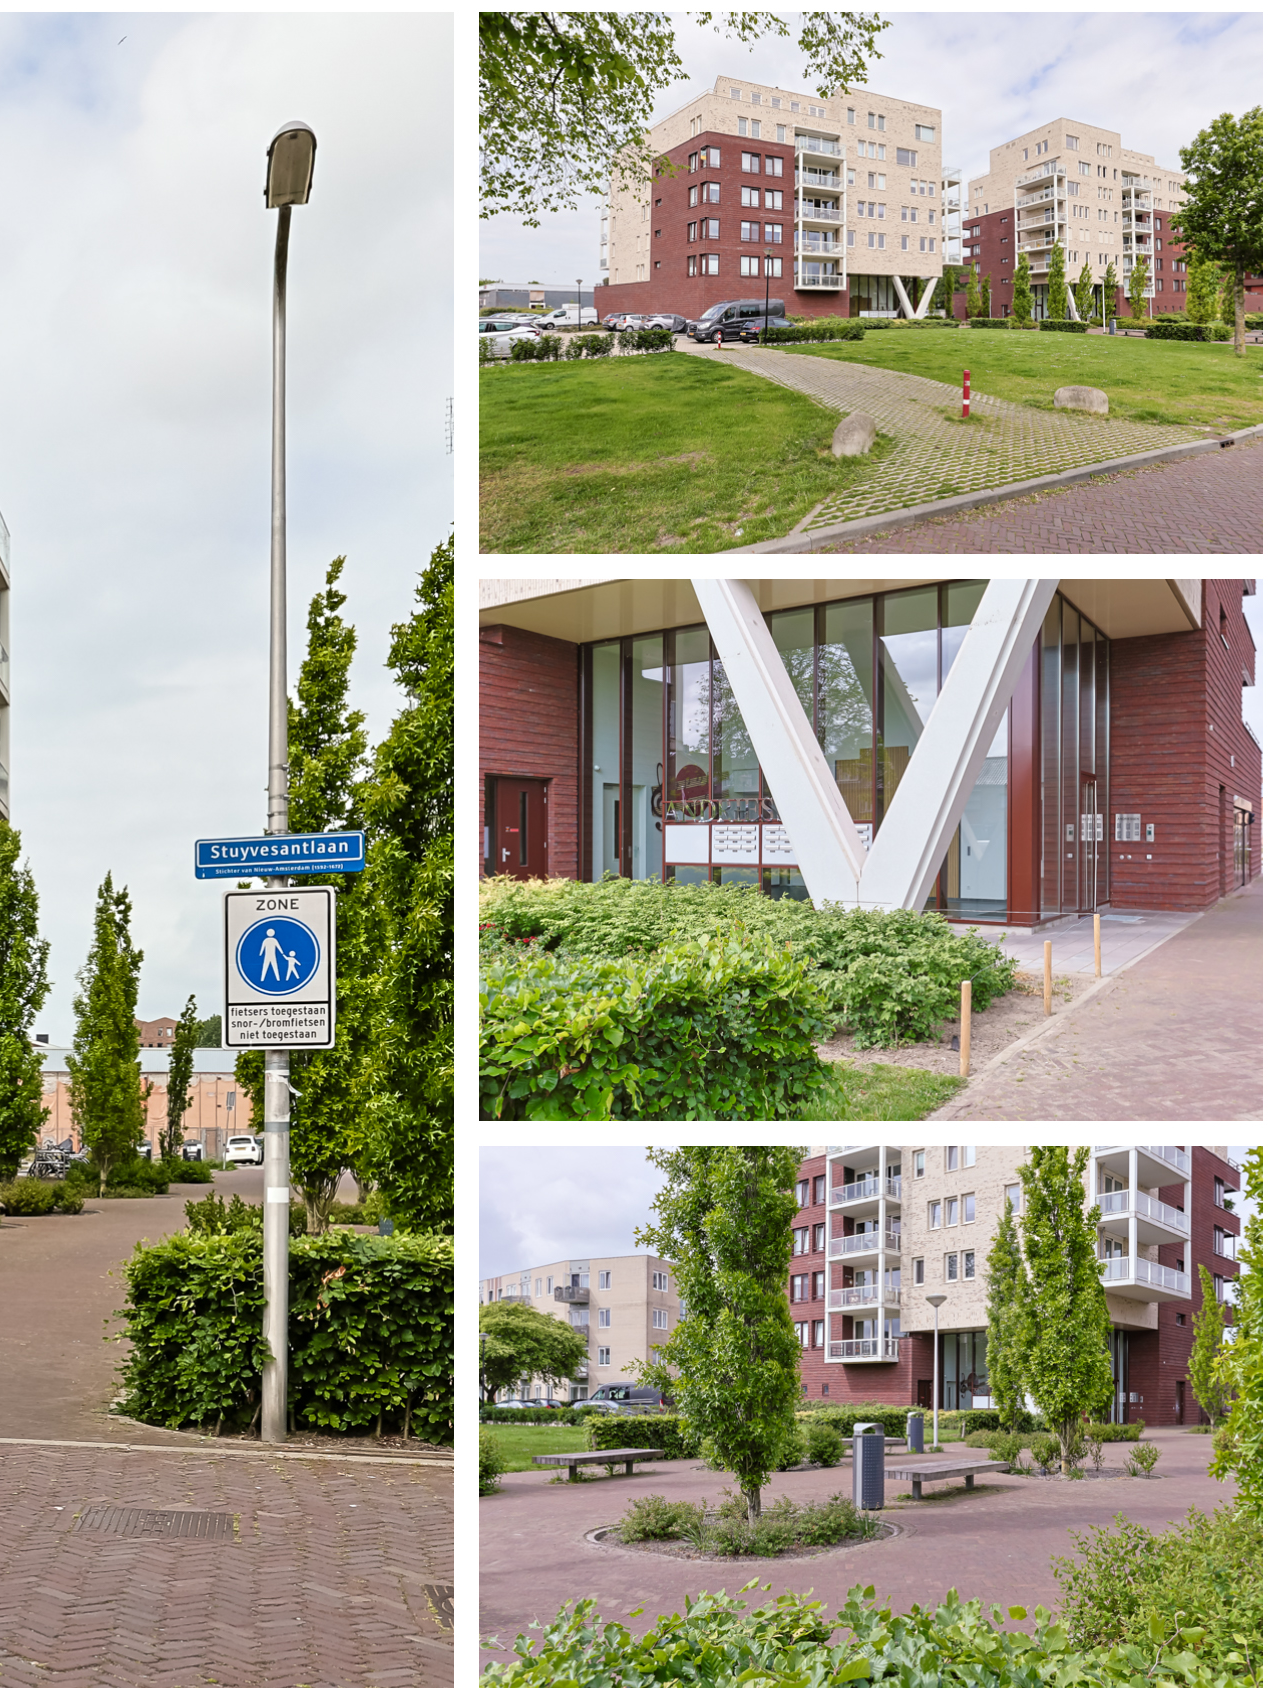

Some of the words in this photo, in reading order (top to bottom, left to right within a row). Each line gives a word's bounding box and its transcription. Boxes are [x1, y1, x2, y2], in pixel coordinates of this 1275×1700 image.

[210, 840, 349, 861] Stuyvesantlaan
[215, 867, 240, 875] Stichter
[253, 864, 311, 873] Nieuw-Amsterdam
[256, 898, 299, 911] ZONE
[231, 1007, 269, 1017] fietsers
[270, 1006, 326, 1018] toegestaan
[240, 1030, 260, 1040] niet
[262, 1030, 317, 1042] toegestaan
